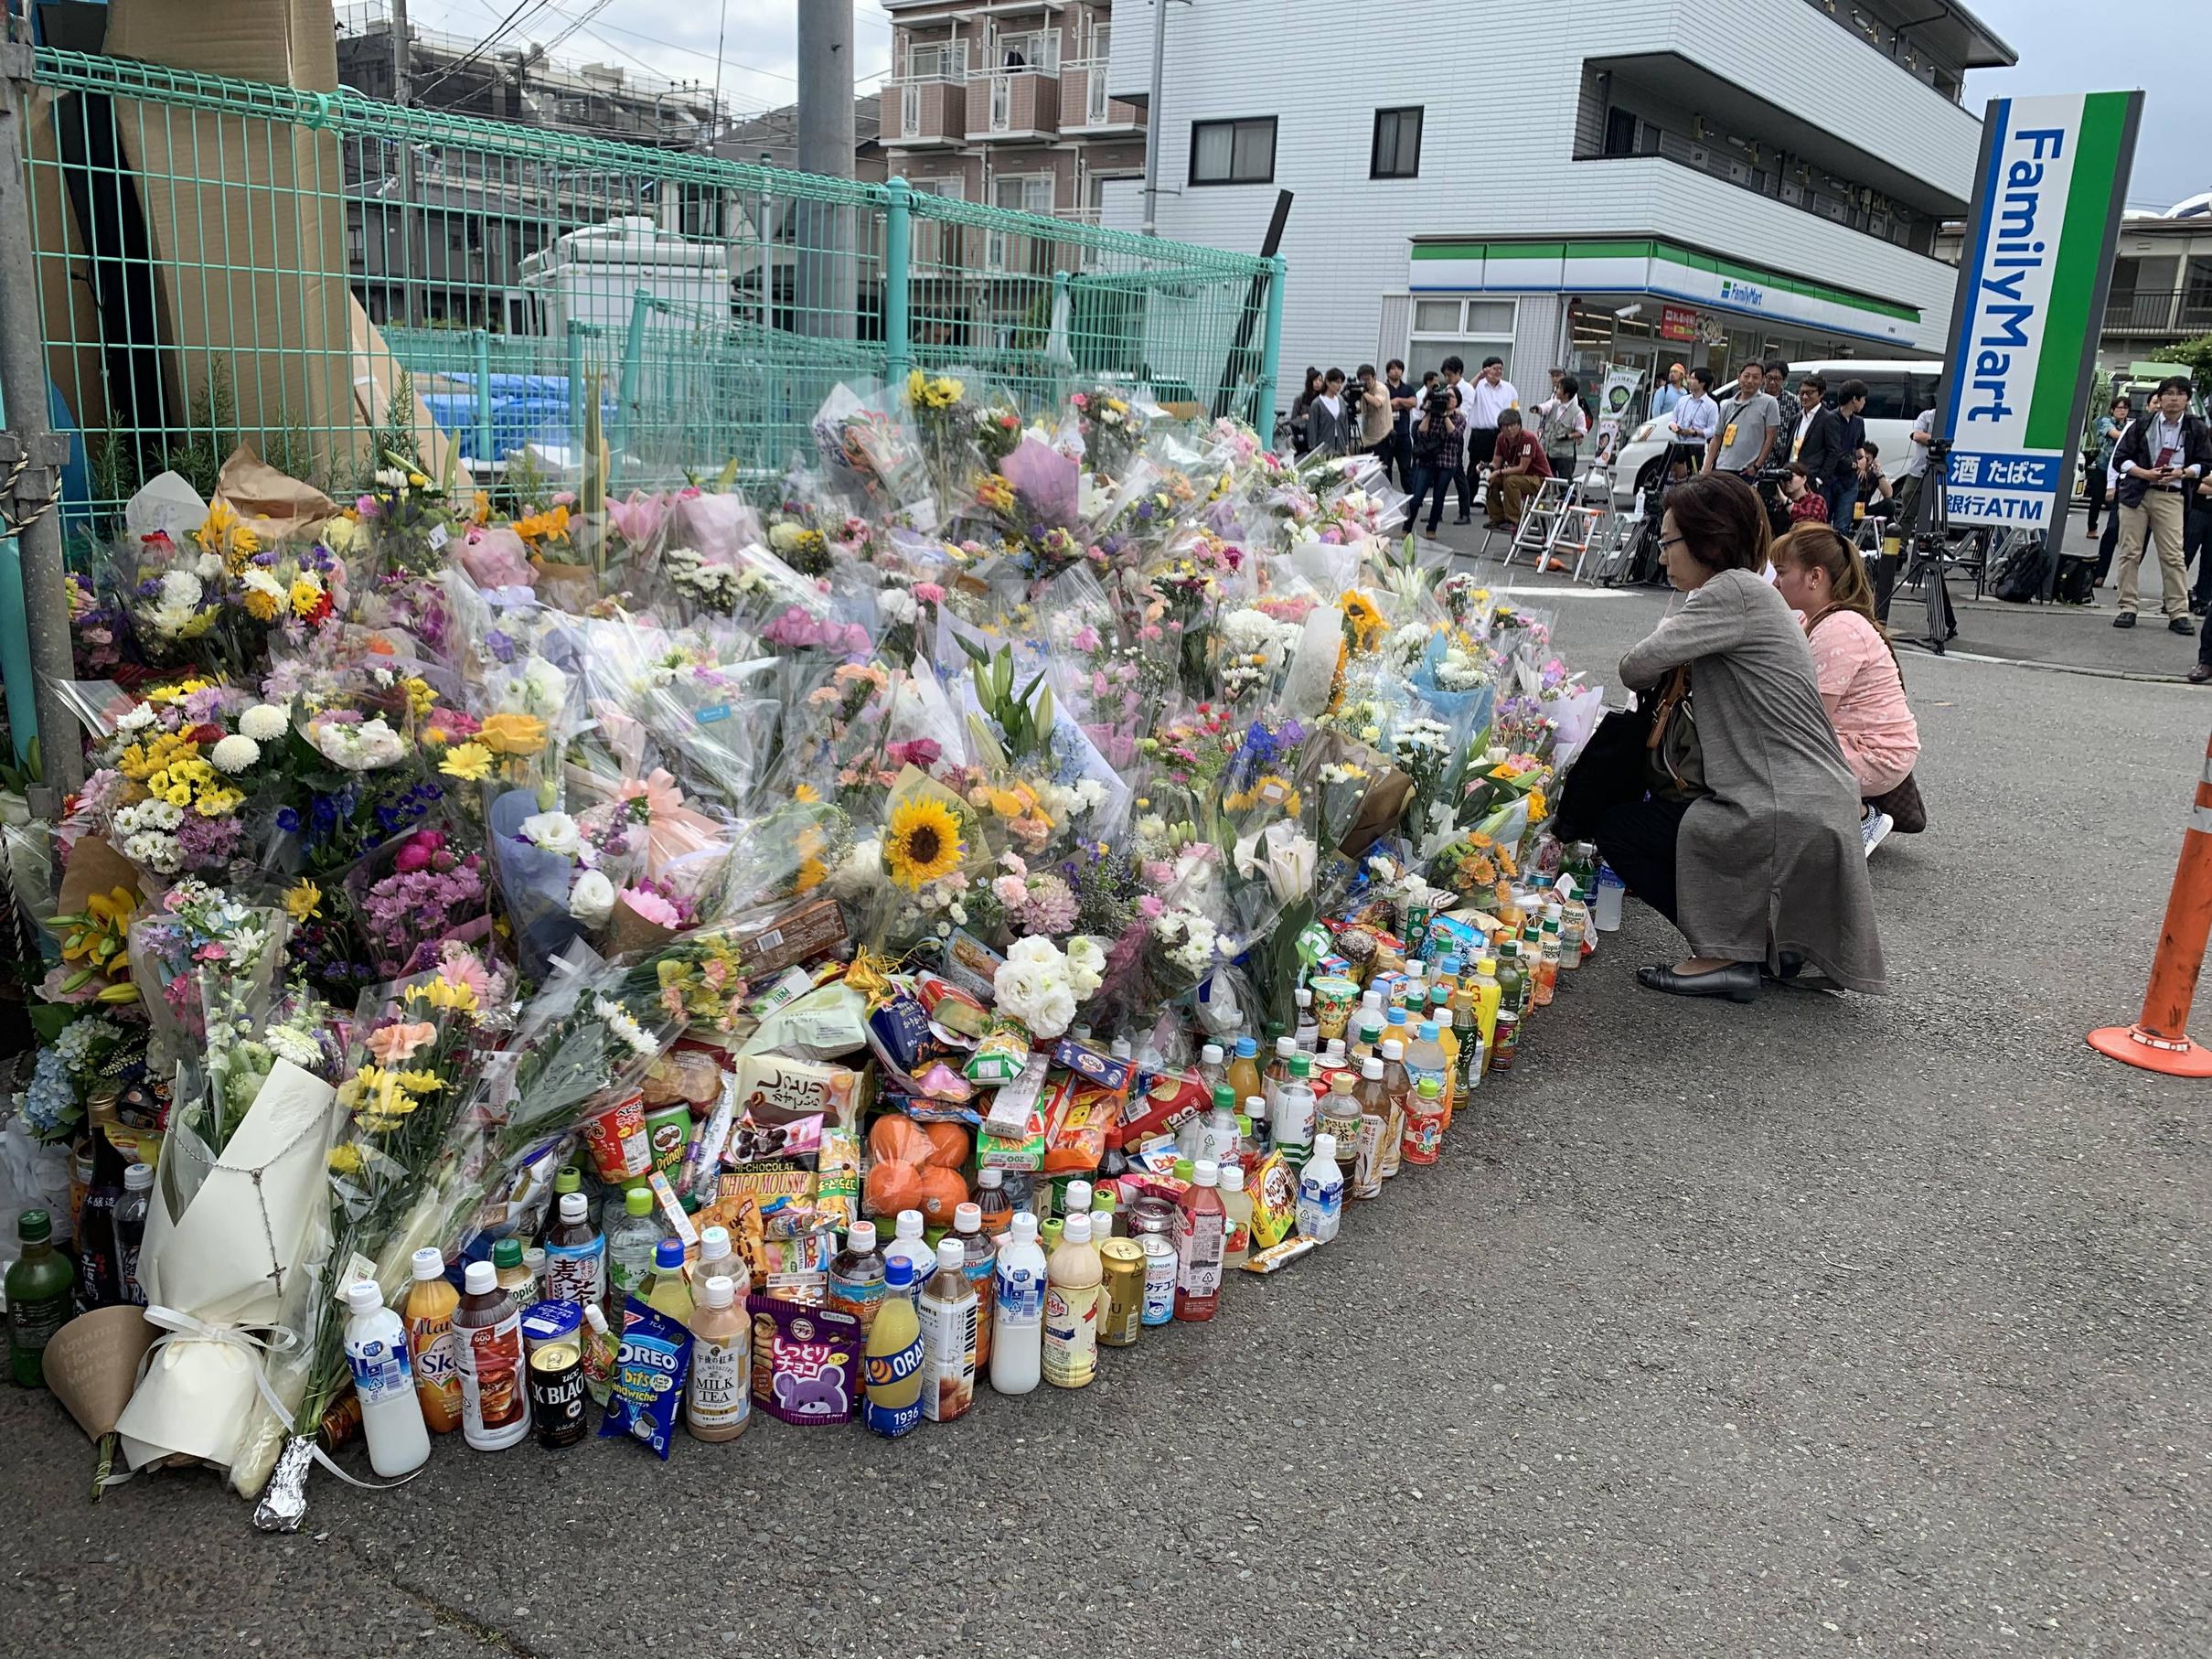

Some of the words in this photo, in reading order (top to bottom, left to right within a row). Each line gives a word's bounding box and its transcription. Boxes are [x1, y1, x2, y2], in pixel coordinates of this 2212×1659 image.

[1966, 128, 2065, 423] FamilyMart
[1732, 283, 1762, 306] FamilyMart
[1950, 455, 1981, 484] 酒
[1987, 460, 2046, 485] たばこ
[1947, 494, 2043, 520] 銀行ATM
[757, 1068, 825, 1096] しっとり
[1325, 1118, 1351, 1129] やさしい
[657, 1143, 687, 1171] Pringle
[1417, 1142, 1435, 1151] Qoo
[734, 1161, 796, 1172] HI-CHOCOLAT
[1152, 1154, 1178, 1170] Dole
[718, 1174, 758, 1197] ICHIGO
[758, 1172, 808, 1194] MOUSSE
[818, 1176, 857, 1193] コアラのマーチ
[806, 1236, 819, 1268] Dole
[552, 1258, 597, 1309] 麦茶
[628, 1268, 648, 1278] いろ
[509, 1280, 538, 1300] opica
[1047, 1301, 1064, 1313] kkle
[413, 1319, 453, 1335] Man
[59, 1323, 122, 1354] Aoyama
[475, 1334, 491, 1343] 600
[64, 1340, 119, 1372] Flower
[617, 1343, 677, 1370] OREO
[697, 1354, 735, 1365] 午後の紅茶
[774, 1338, 830, 1364] しっとり
[893, 1333, 924, 1376] ORAN
[68, 1354, 123, 1385] Market
[422, 1354, 458, 1375] Sk
[776, 1355, 818, 1376] チョコ
[625, 1368, 650, 1386] bits
[696, 1377, 734, 1389] MILK
[547, 1373, 584, 1405] BLAC
[613, 1383, 658, 1402] andwiches
[699, 1391, 731, 1402] TEA
[893, 1407, 919, 1425] 1936
